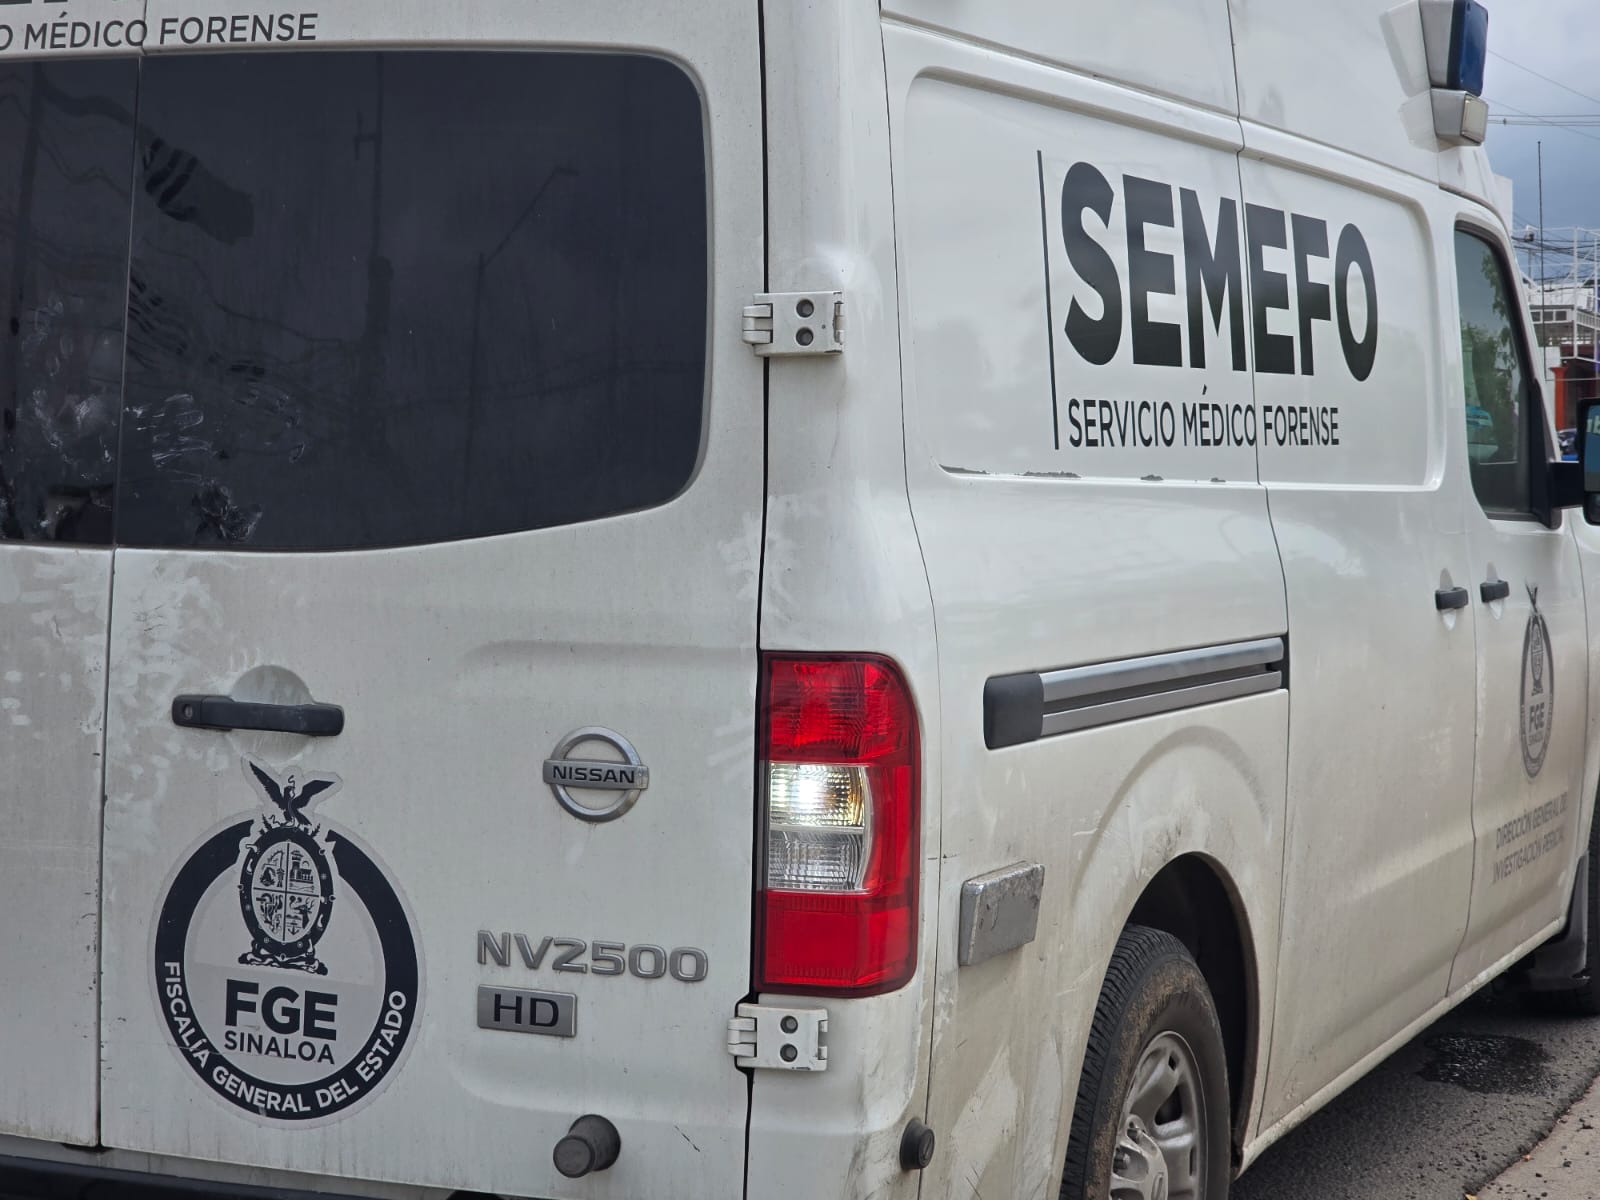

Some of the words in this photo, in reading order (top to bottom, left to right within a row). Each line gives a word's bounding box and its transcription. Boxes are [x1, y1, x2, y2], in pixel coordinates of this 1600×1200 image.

[24, 11, 148, 50] MÉDICO
[159, 13, 319, 46] FORENSE
[1061, 161, 1379, 382] SEMEFO
[1068, 398, 1176, 448] SERVICIO
[1182, 383, 1257, 447] MÉDICO
[1263, 405, 1340, 447] FORENSE
[552, 764, 635, 784] NISSAN
[477, 929, 709, 982] NV2500
[225, 978, 338, 1041] FGE
[493, 993, 560, 1028] HD
[164, 961, 209, 1069] FISCALÍA
[211, 1064, 311, 1113] GENERAL
[315, 1076, 359, 1109] DEL
[355, 990, 407, 1082] ESTADO
[224, 1029, 335, 1065] SINALOA
